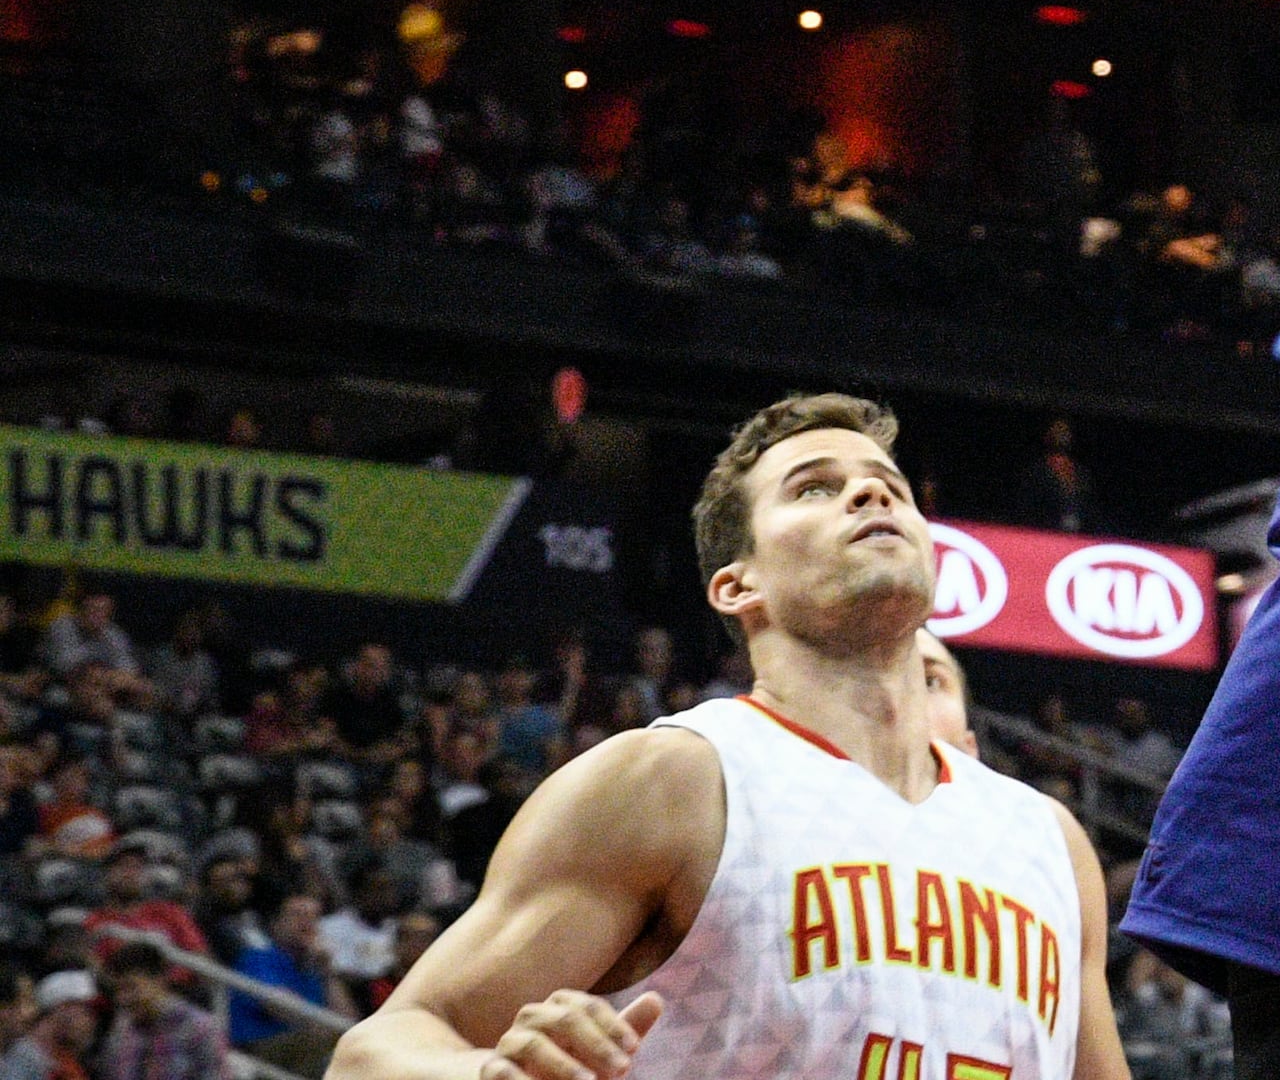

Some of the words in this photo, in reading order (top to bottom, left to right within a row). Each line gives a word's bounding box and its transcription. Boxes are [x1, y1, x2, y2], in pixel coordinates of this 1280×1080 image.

[8, 445, 326, 562] HAWKS
[1072, 567, 1182, 636] KIA
[785, 861, 1061, 1039] ATLANTA
